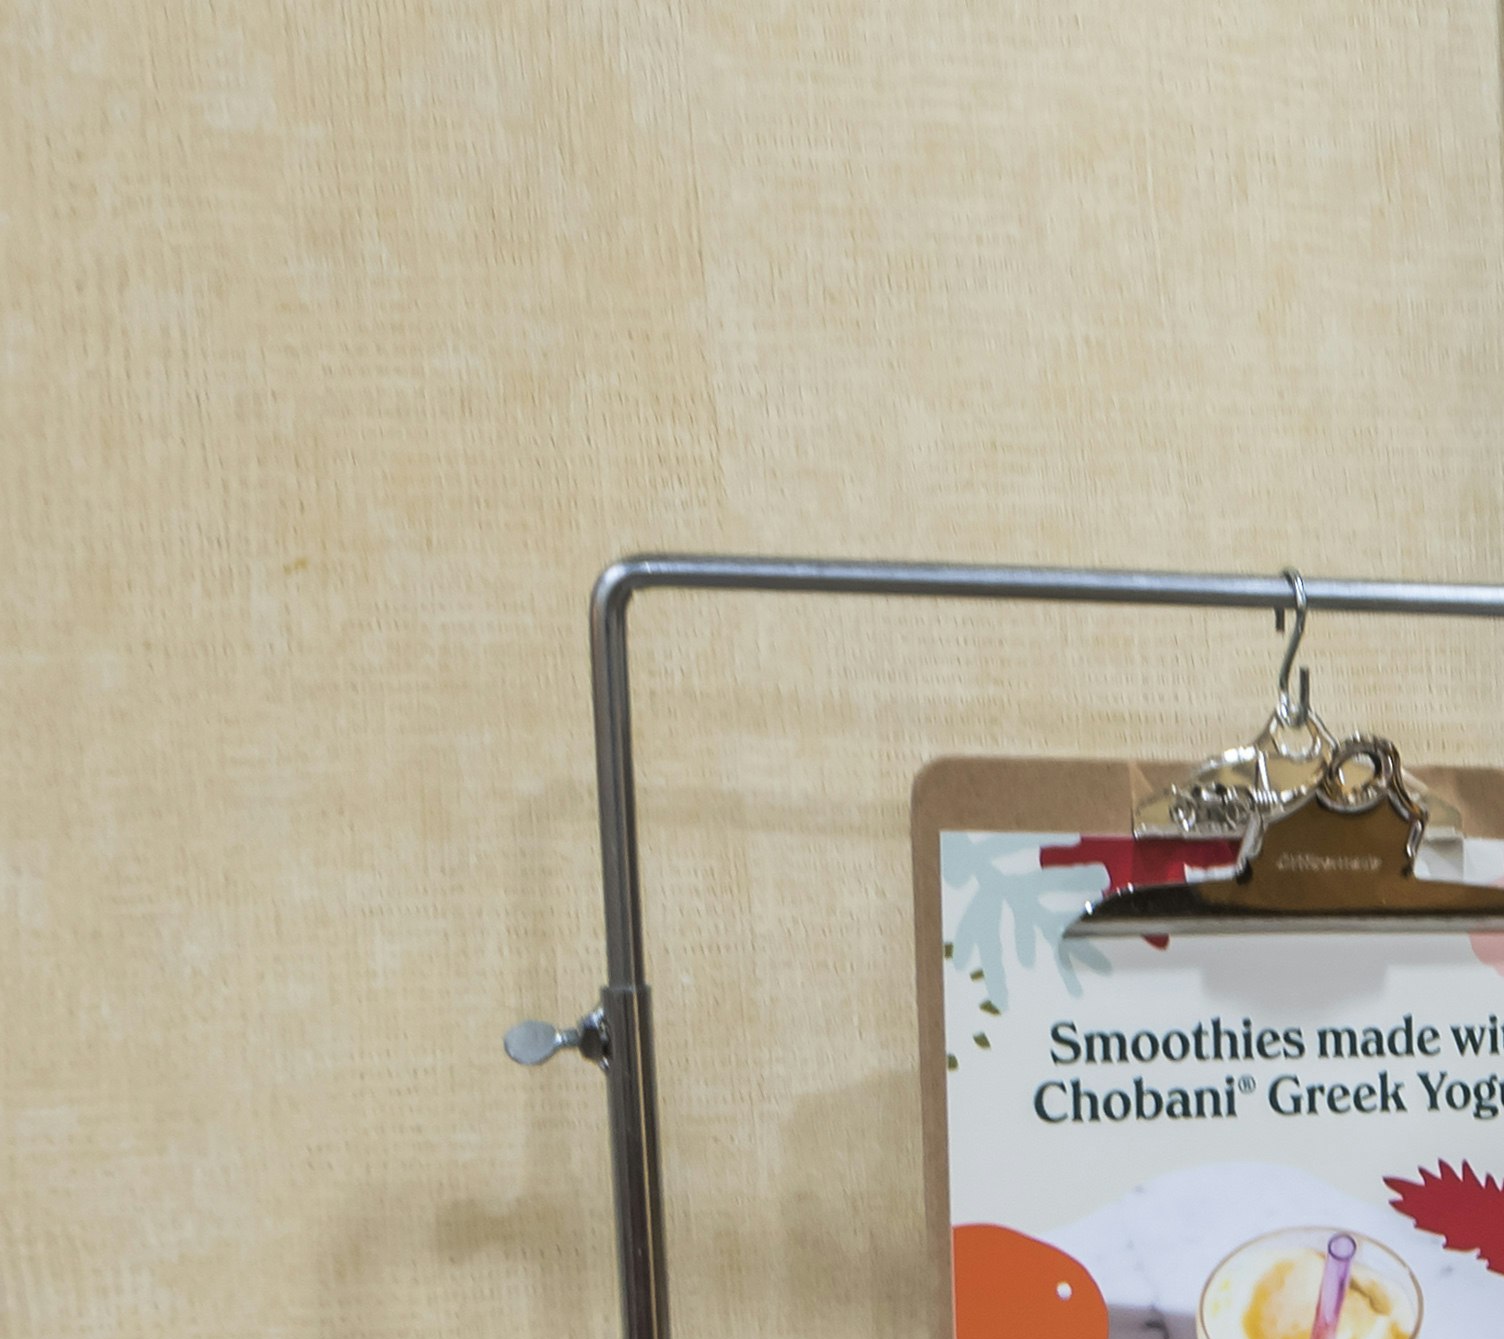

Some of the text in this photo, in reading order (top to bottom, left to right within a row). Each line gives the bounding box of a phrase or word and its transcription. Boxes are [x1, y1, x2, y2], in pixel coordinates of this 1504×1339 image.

[1050, 1017, 1306, 1065] Smoothies
[1317, 1014, 1441, 1058] made
[1268, 1070, 1407, 1116] Greek
